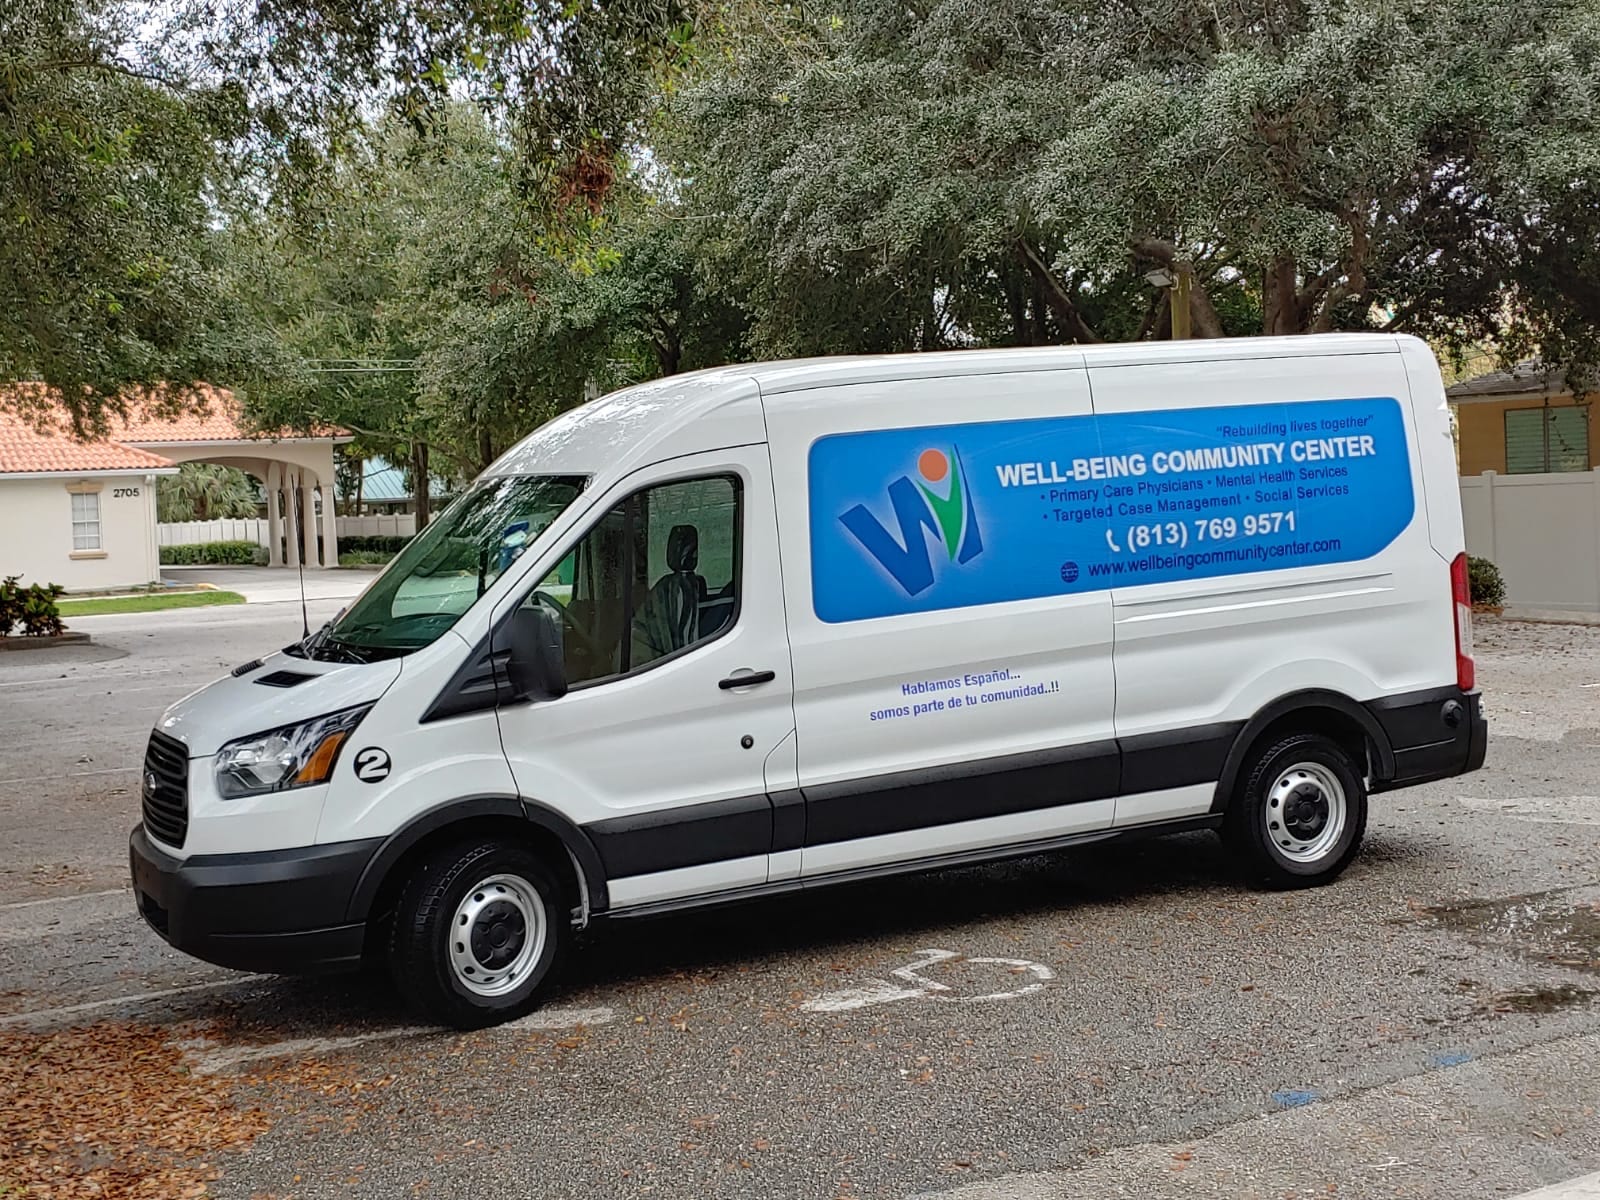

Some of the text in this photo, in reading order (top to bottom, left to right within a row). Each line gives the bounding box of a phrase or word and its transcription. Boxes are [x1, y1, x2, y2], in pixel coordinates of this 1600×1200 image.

[1290, 419, 1317, 432] lives
[995, 435, 1376, 487] WELL-BEING COMMUNITY CENTER
[113, 487, 140, 498] 2705
[1050, 466, 1348, 502] Primary Care Physicians Mental Health Services
[1053, 484, 1349, 523] Targeted Case Management Social Services
[1127, 510, 1296, 553] (813) 769 9571
[1087, 537, 1341, 577] www.wellbeingcommunitycenter.com
[870, 680, 1060, 721] somos parte de tu comunidad..!!
[902, 669, 1021, 696] Hablamos Español...
[358, 749, 388, 779] 2
